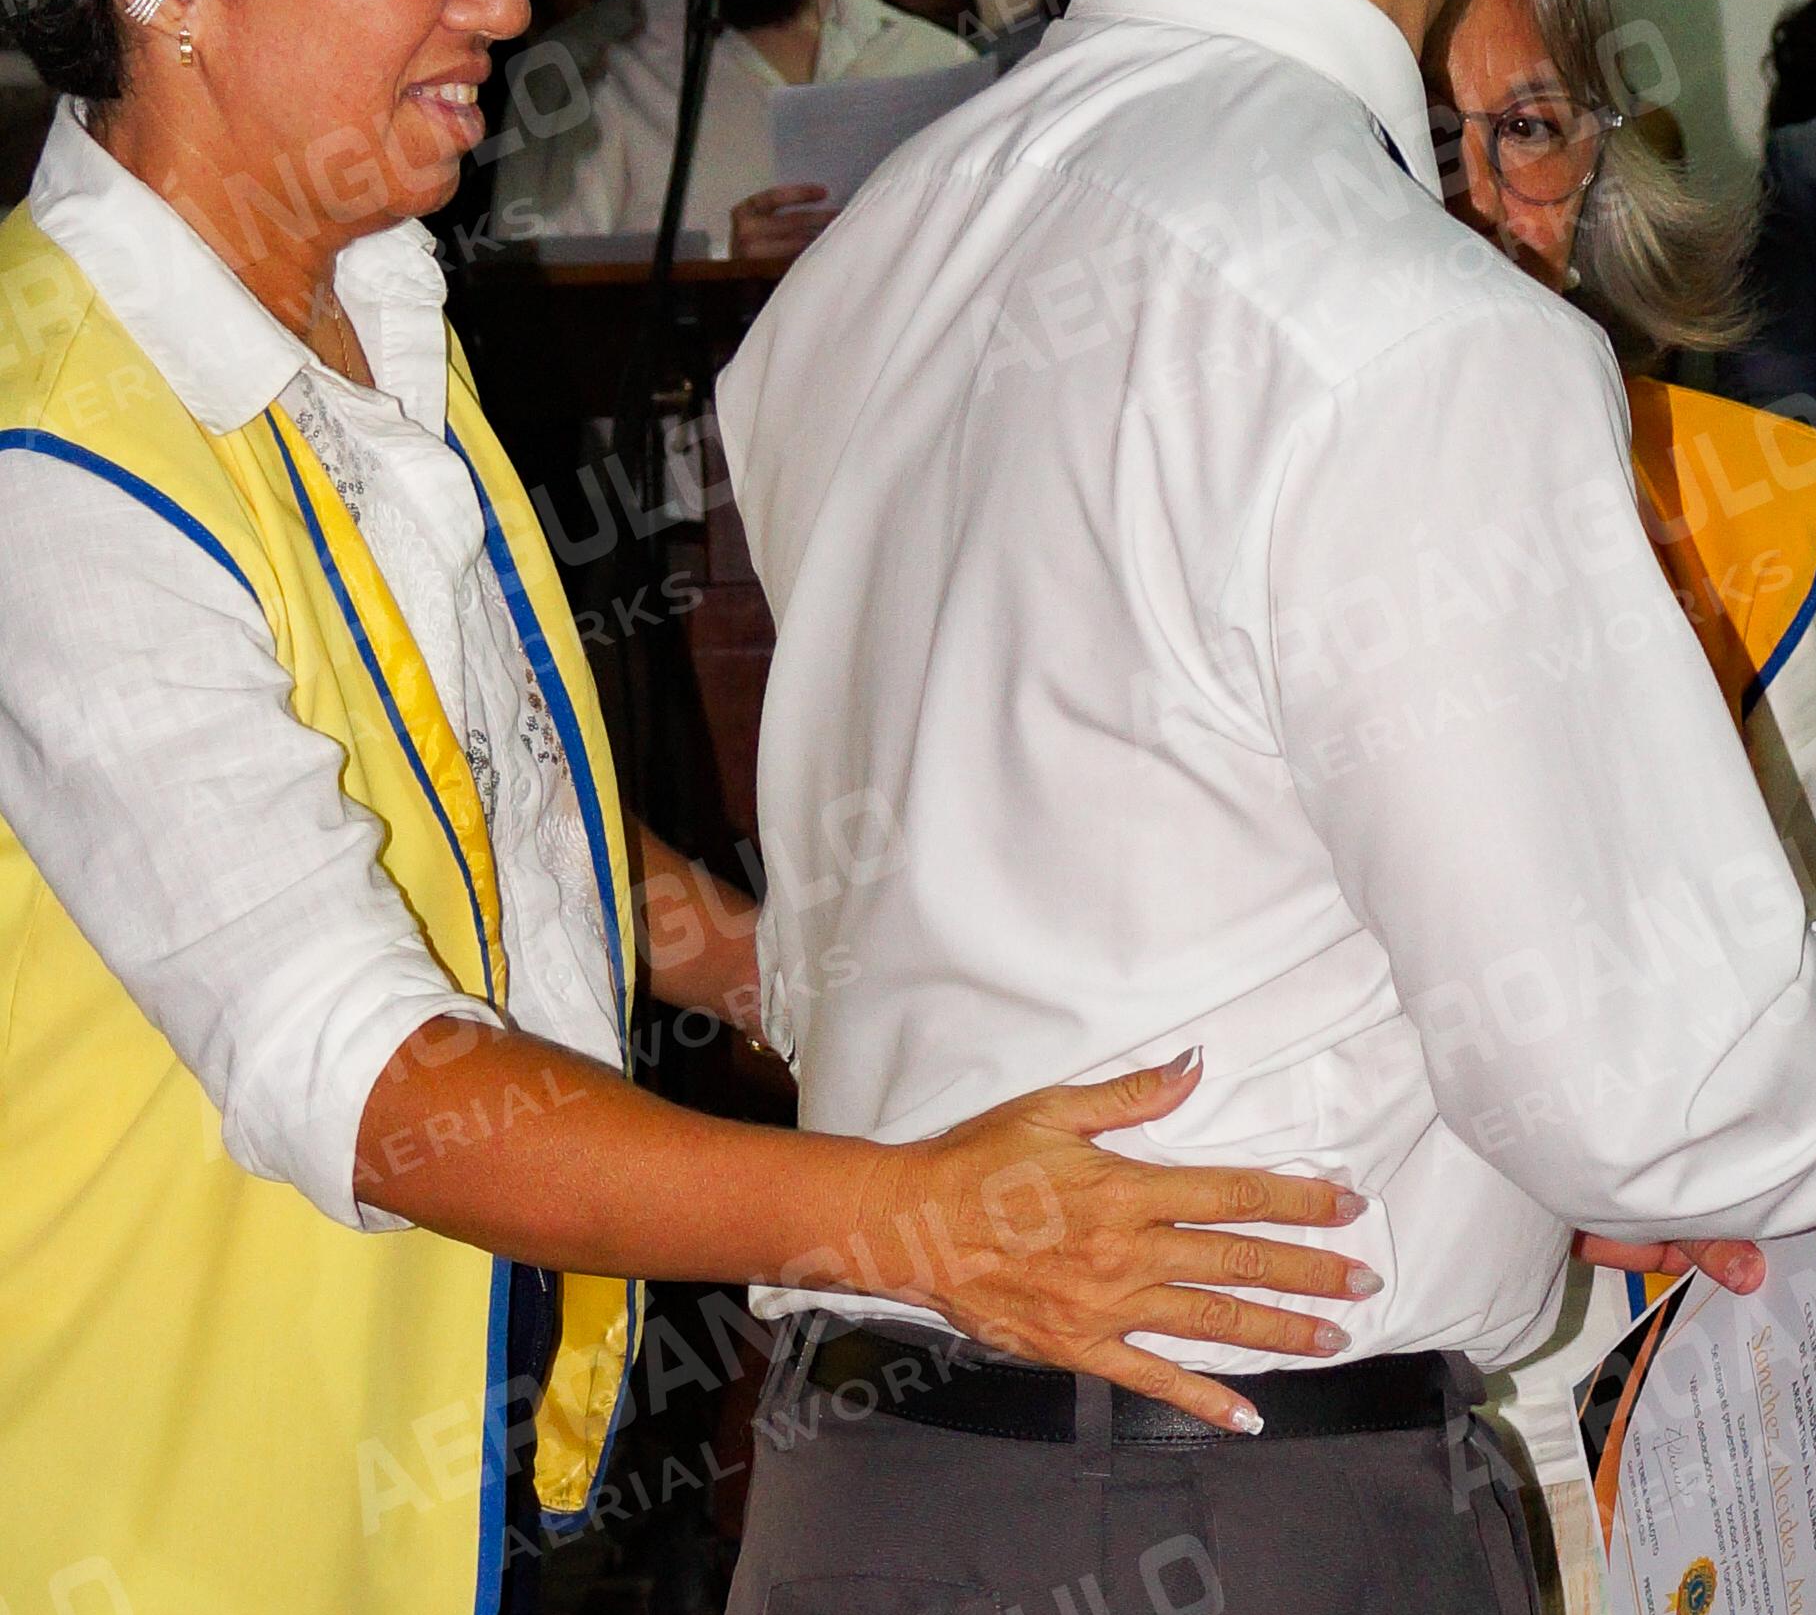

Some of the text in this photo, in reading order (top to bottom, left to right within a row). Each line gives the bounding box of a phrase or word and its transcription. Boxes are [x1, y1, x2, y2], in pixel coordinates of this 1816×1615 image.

[1798, 1341, 1807, 1363] DE
[1801, 1364, 1810, 1386] LA
[1791, 1380, 1808, 1461] ARGENTINA
[1802, 1464, 1811, 1485] AL
[1767, 1463, 1800, 1567] Alcides
